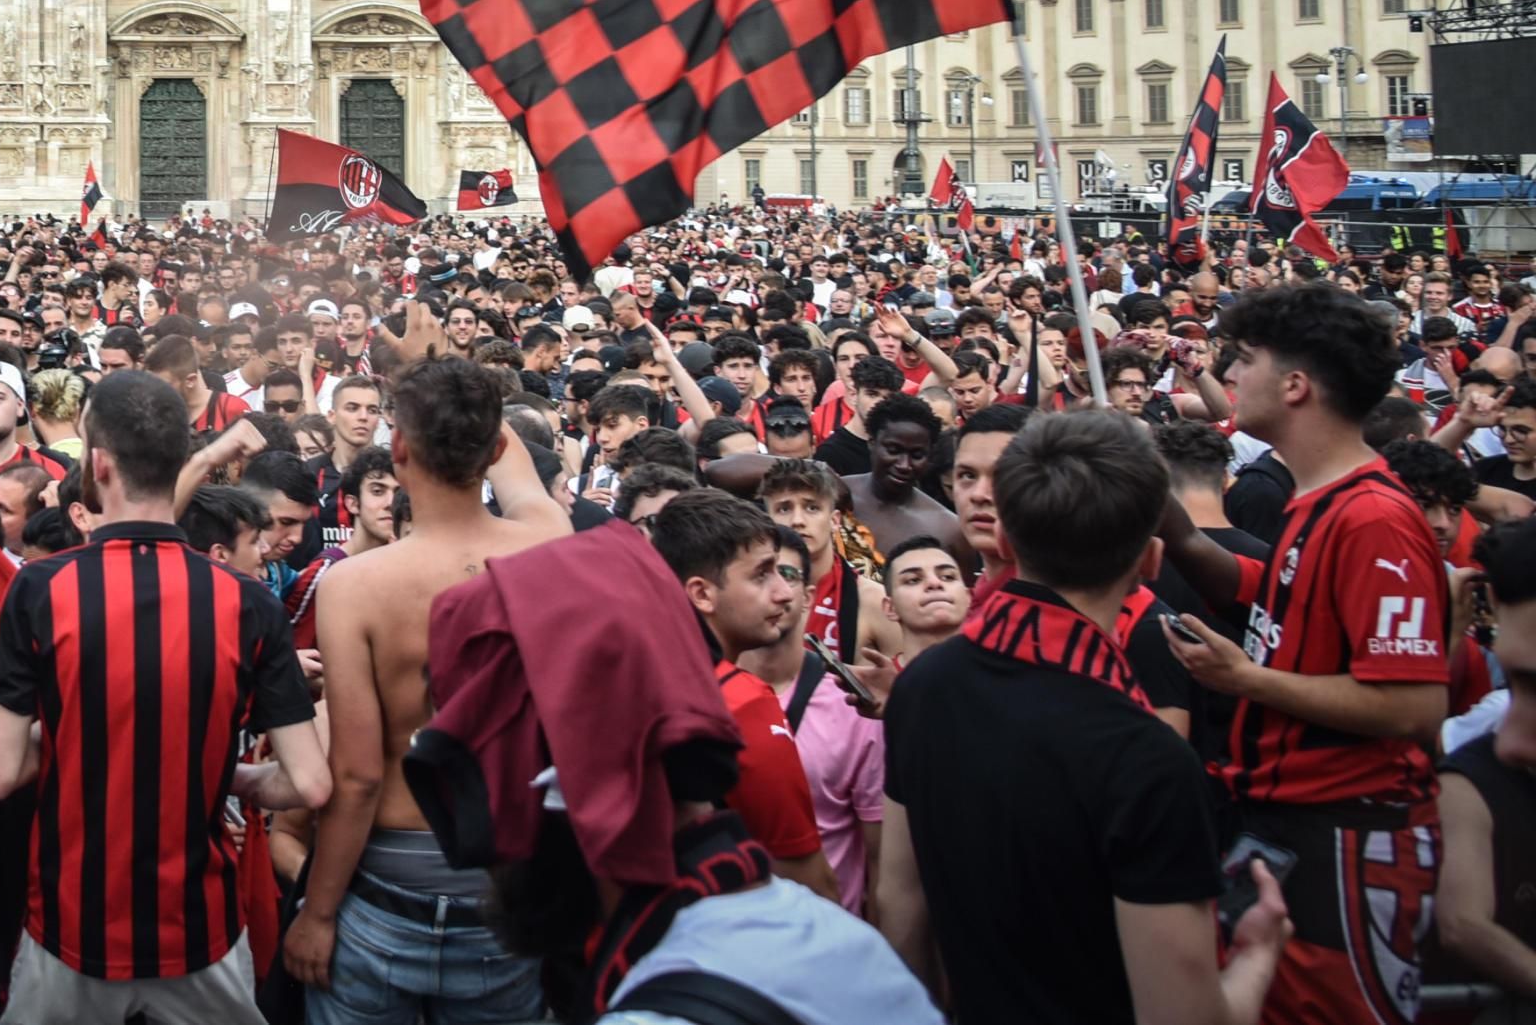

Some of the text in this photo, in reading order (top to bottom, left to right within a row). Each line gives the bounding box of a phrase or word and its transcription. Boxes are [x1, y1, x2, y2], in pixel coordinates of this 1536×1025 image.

[1015, 164, 1027, 179] M
[1228, 163, 1240, 176] E
[1368, 638, 1438, 655] BitMEX
